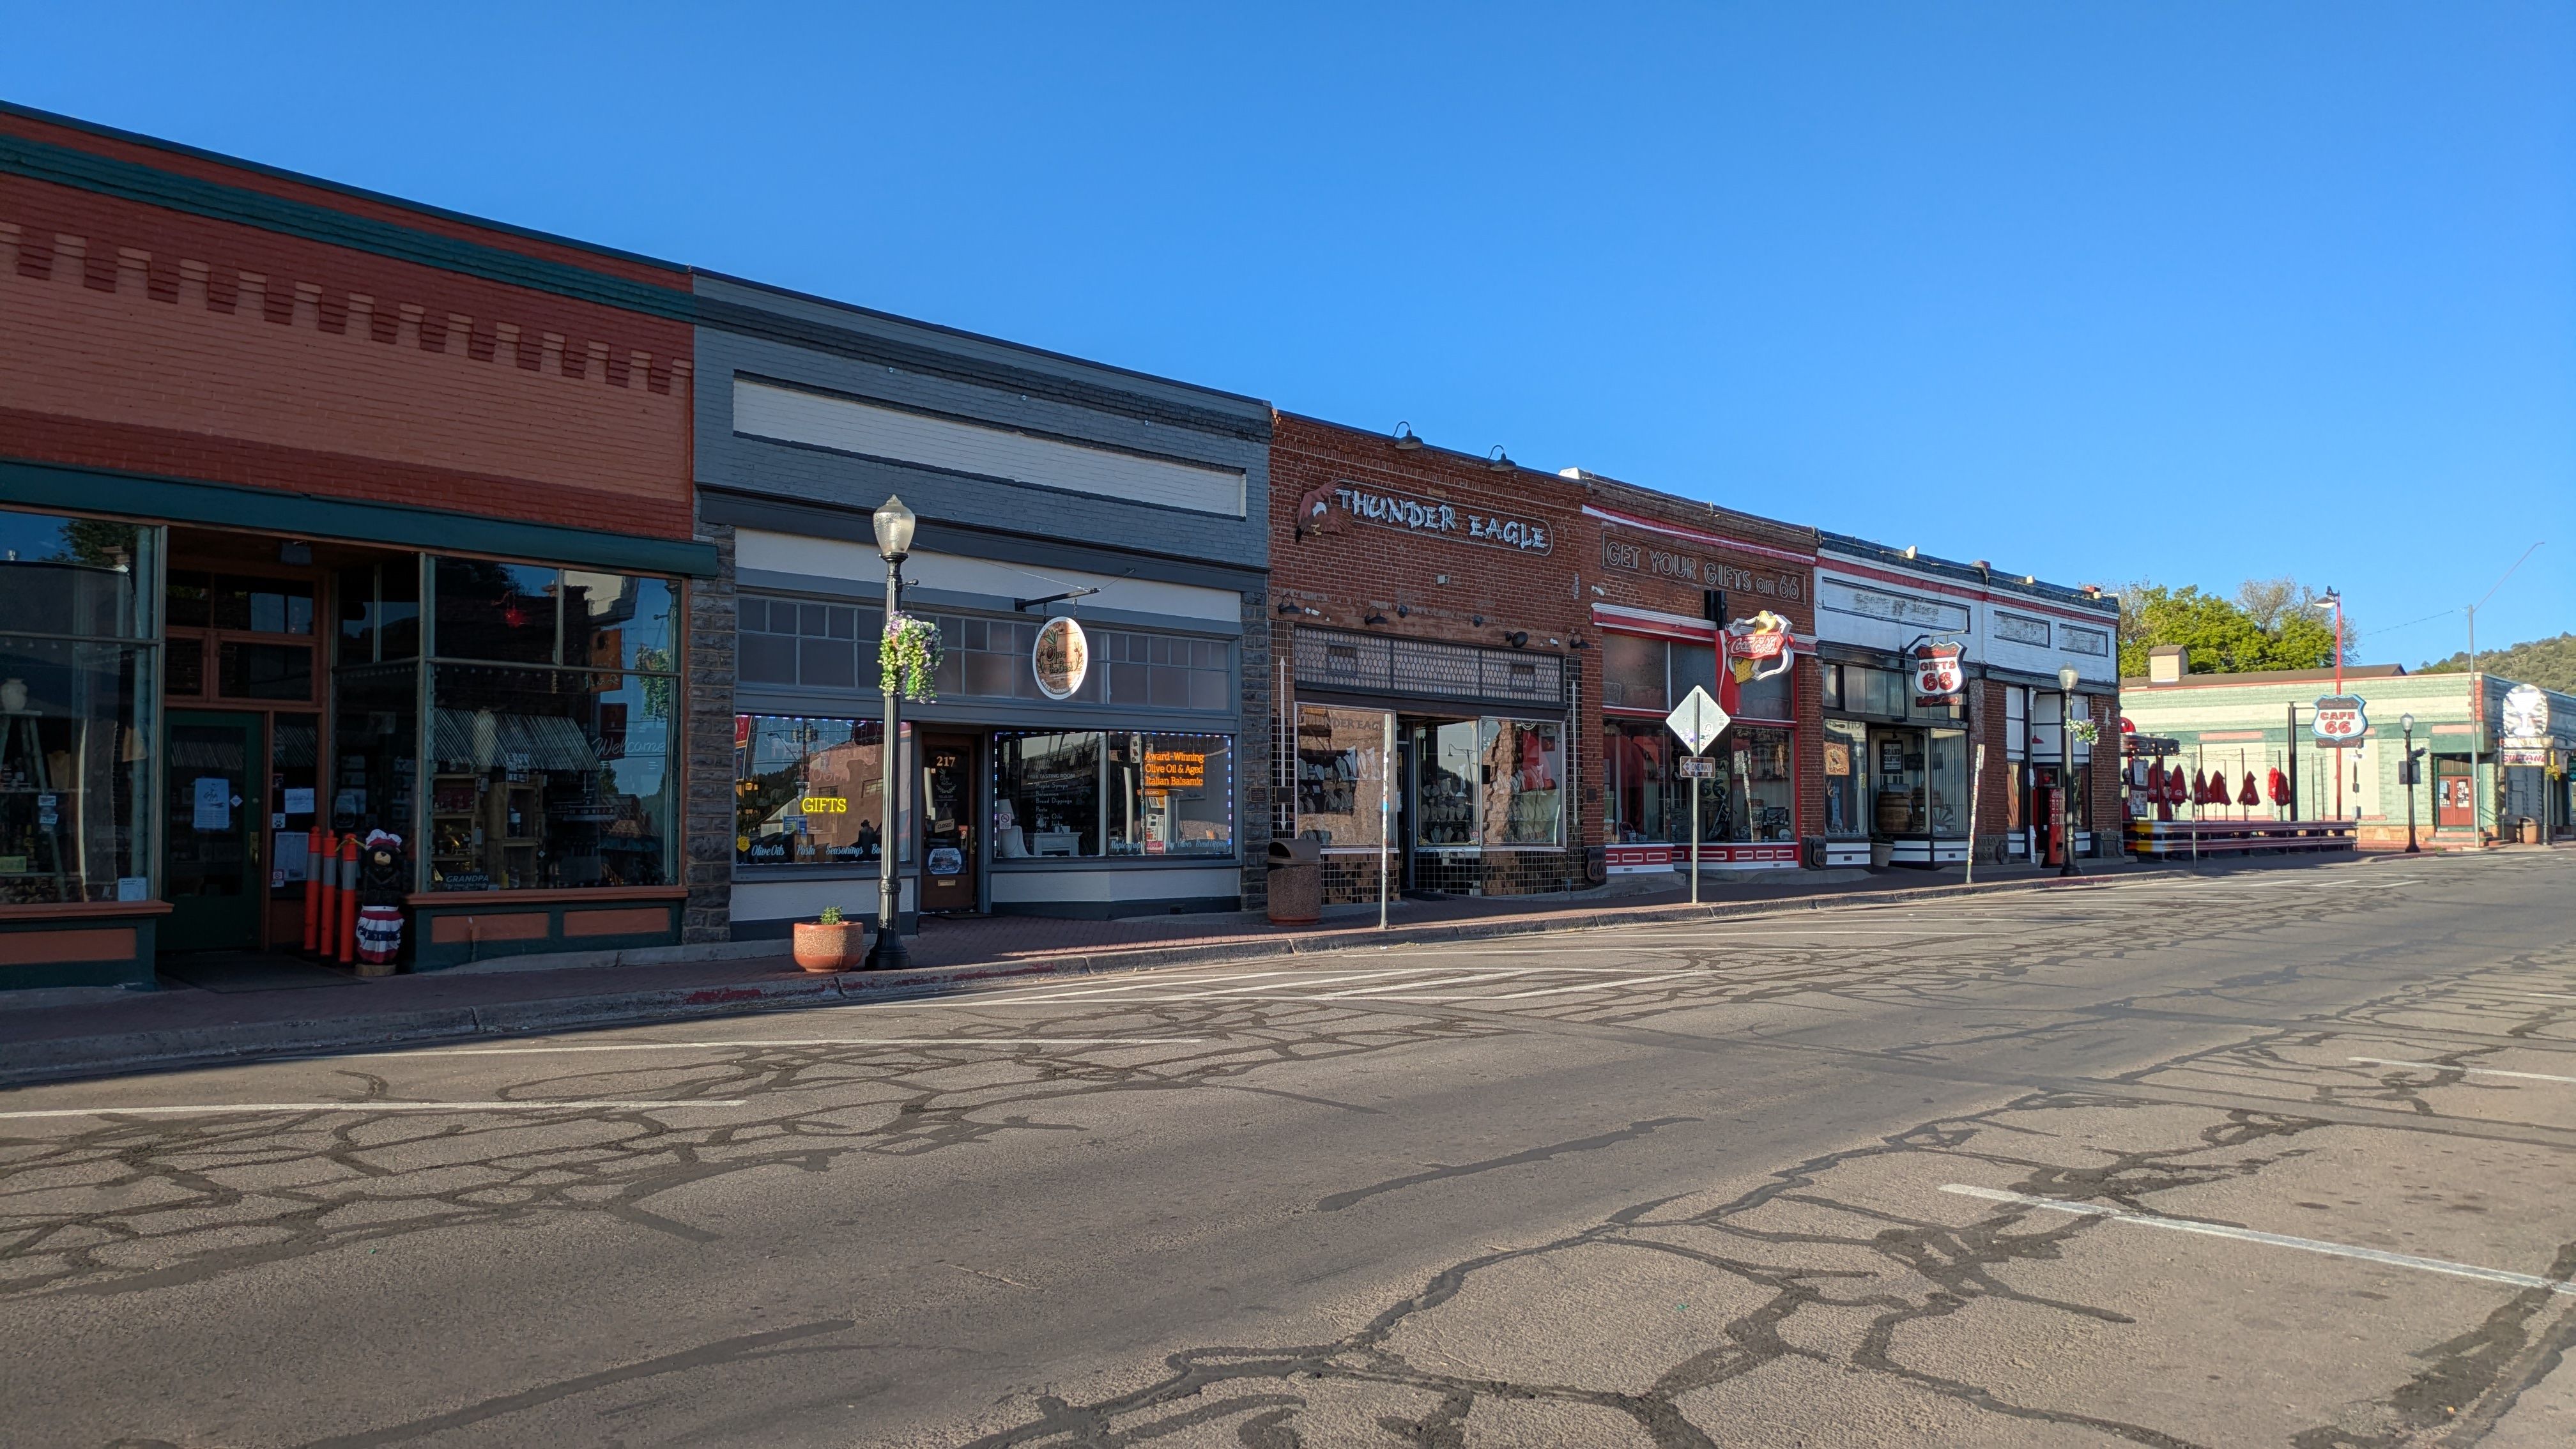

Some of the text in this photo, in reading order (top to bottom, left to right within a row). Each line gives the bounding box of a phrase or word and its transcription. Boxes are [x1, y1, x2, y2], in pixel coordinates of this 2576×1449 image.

[1335, 488, 1549, 549] THUNDER EAGLE
[1607, 542, 1799, 599] GET YOUR GIFTS on 66
[1920, 660, 1956, 671] GIFTS
[1922, 671, 1954, 691] 66
[2320, 711, 2356, 721] CAFE
[1357, 720, 1385, 732] EAGL
[2324, 721, 2352, 734] 66
[592, 735, 666, 757] Welcome
[936, 756, 956, 767] 217
[1144, 751, 1204, 763] Award-Winning
[2503, 754, 2545, 762] SULTANA
[1145, 764, 1204, 775] Olive Oil & Aged
[1146, 776, 1204, 786] Italian Balsamic
[1699, 779, 1726, 797] 66
[802, 797, 847, 813] GIFTS
[751, 844, 771, 856] Olive
[771, 844, 785, 855] Oils
[797, 843, 816, 856] Pasta
[826, 843, 864, 857] Seasonings
